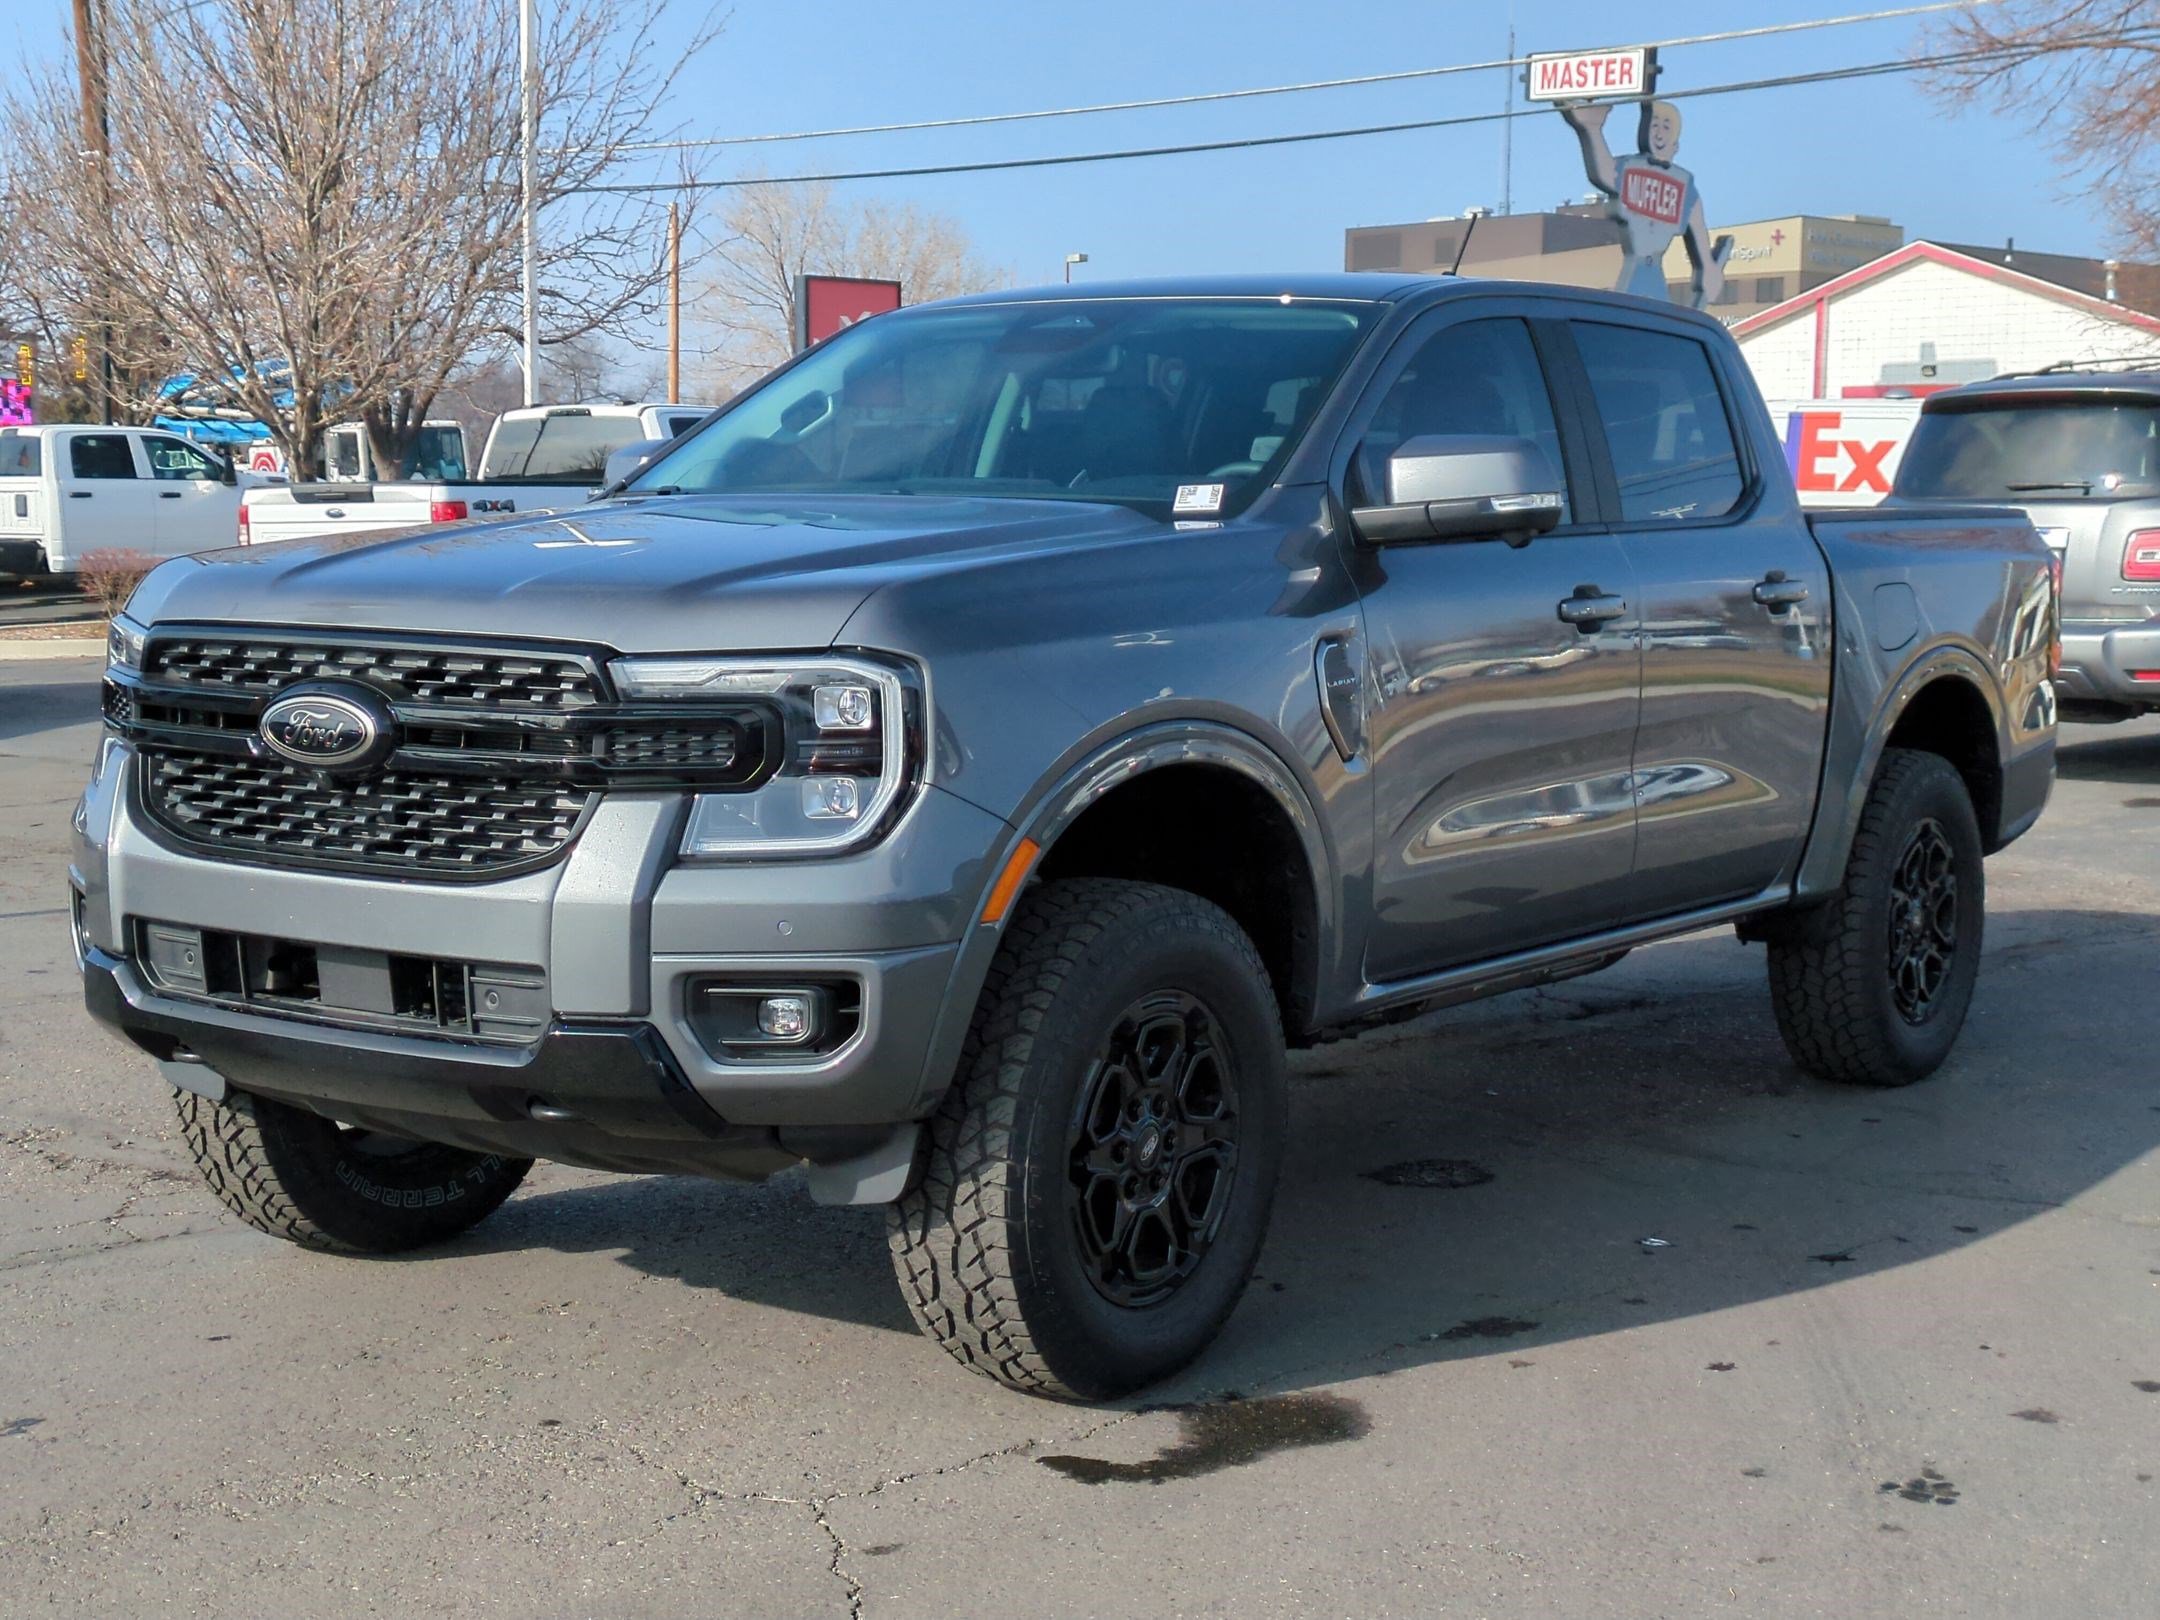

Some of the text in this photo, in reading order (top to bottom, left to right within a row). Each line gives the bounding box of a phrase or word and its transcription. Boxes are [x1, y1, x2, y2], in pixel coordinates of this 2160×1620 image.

[1541, 57, 1633, 89] MASTER
[1627, 173, 1679, 216] MUFFLER
[283, 709, 344, 749] Ford
[335, 1153, 501, 1208] LL TERRAIN
